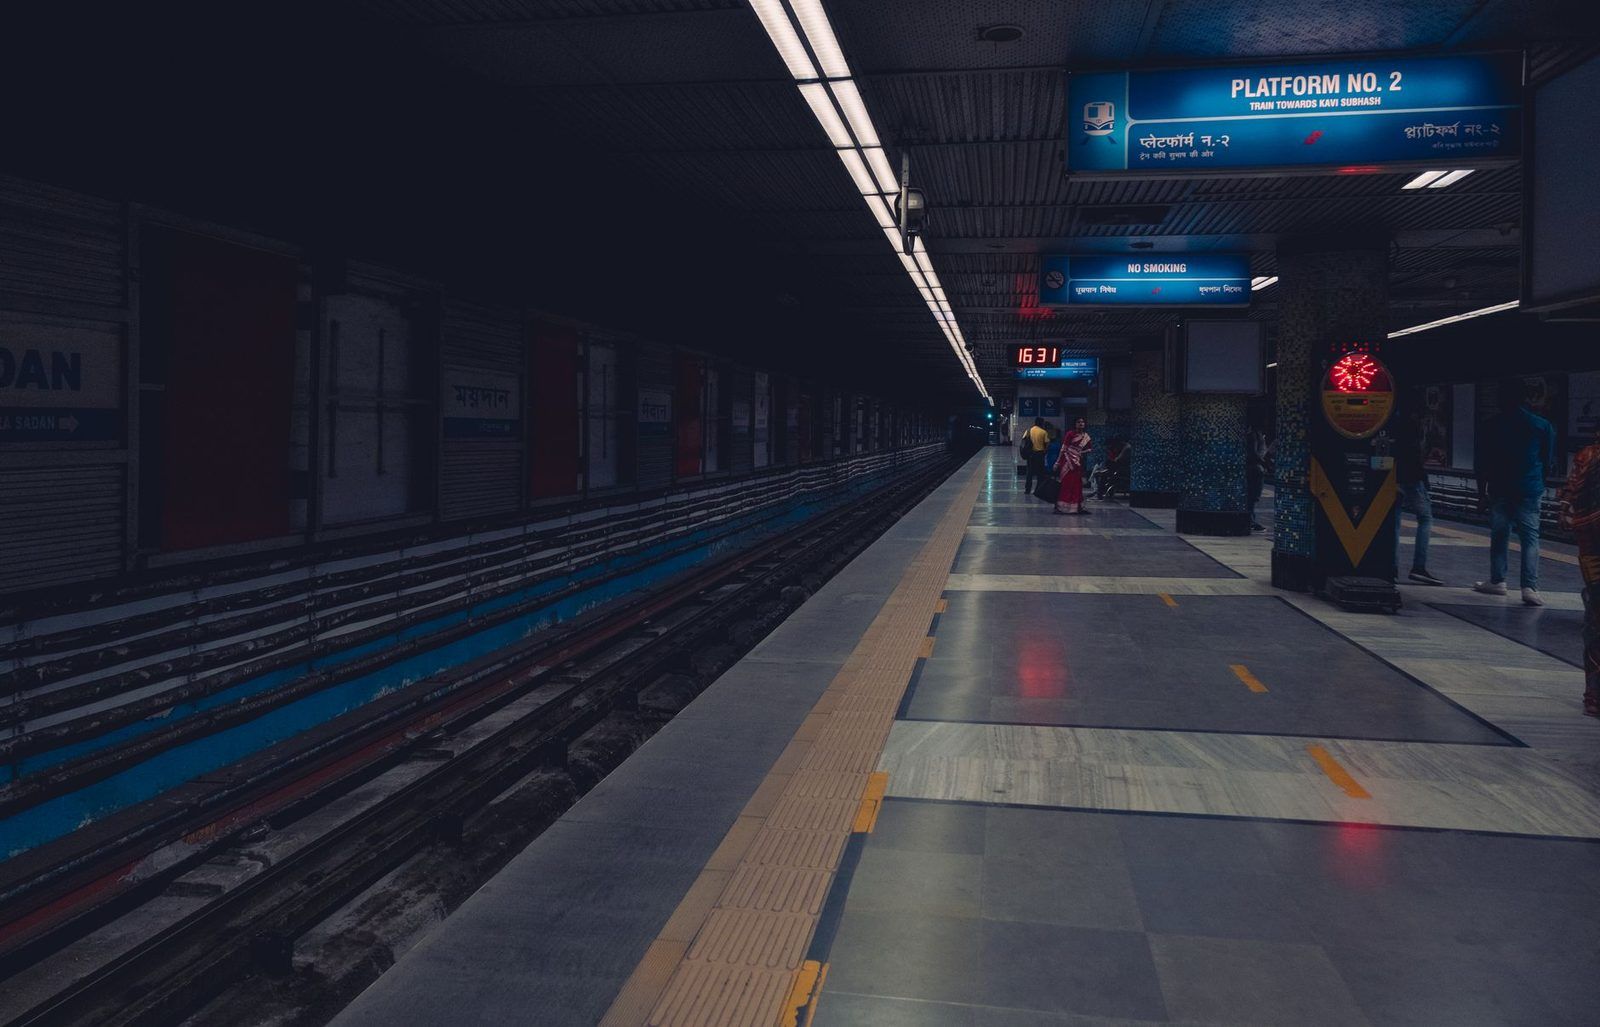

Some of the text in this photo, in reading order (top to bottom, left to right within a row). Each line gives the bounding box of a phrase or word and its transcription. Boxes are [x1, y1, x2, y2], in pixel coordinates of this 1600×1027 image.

[1231, 71, 1403, 98] PLATFORM NO. 2
[1249, 96, 1382, 111] TRAIN TOWARDS KAVI SUBHASH
[1139, 131, 1195, 149] प्लेटफॉर्म
[1127, 263, 1187, 273] NO SMOKING
[15, 415, 55, 433] SADAN
